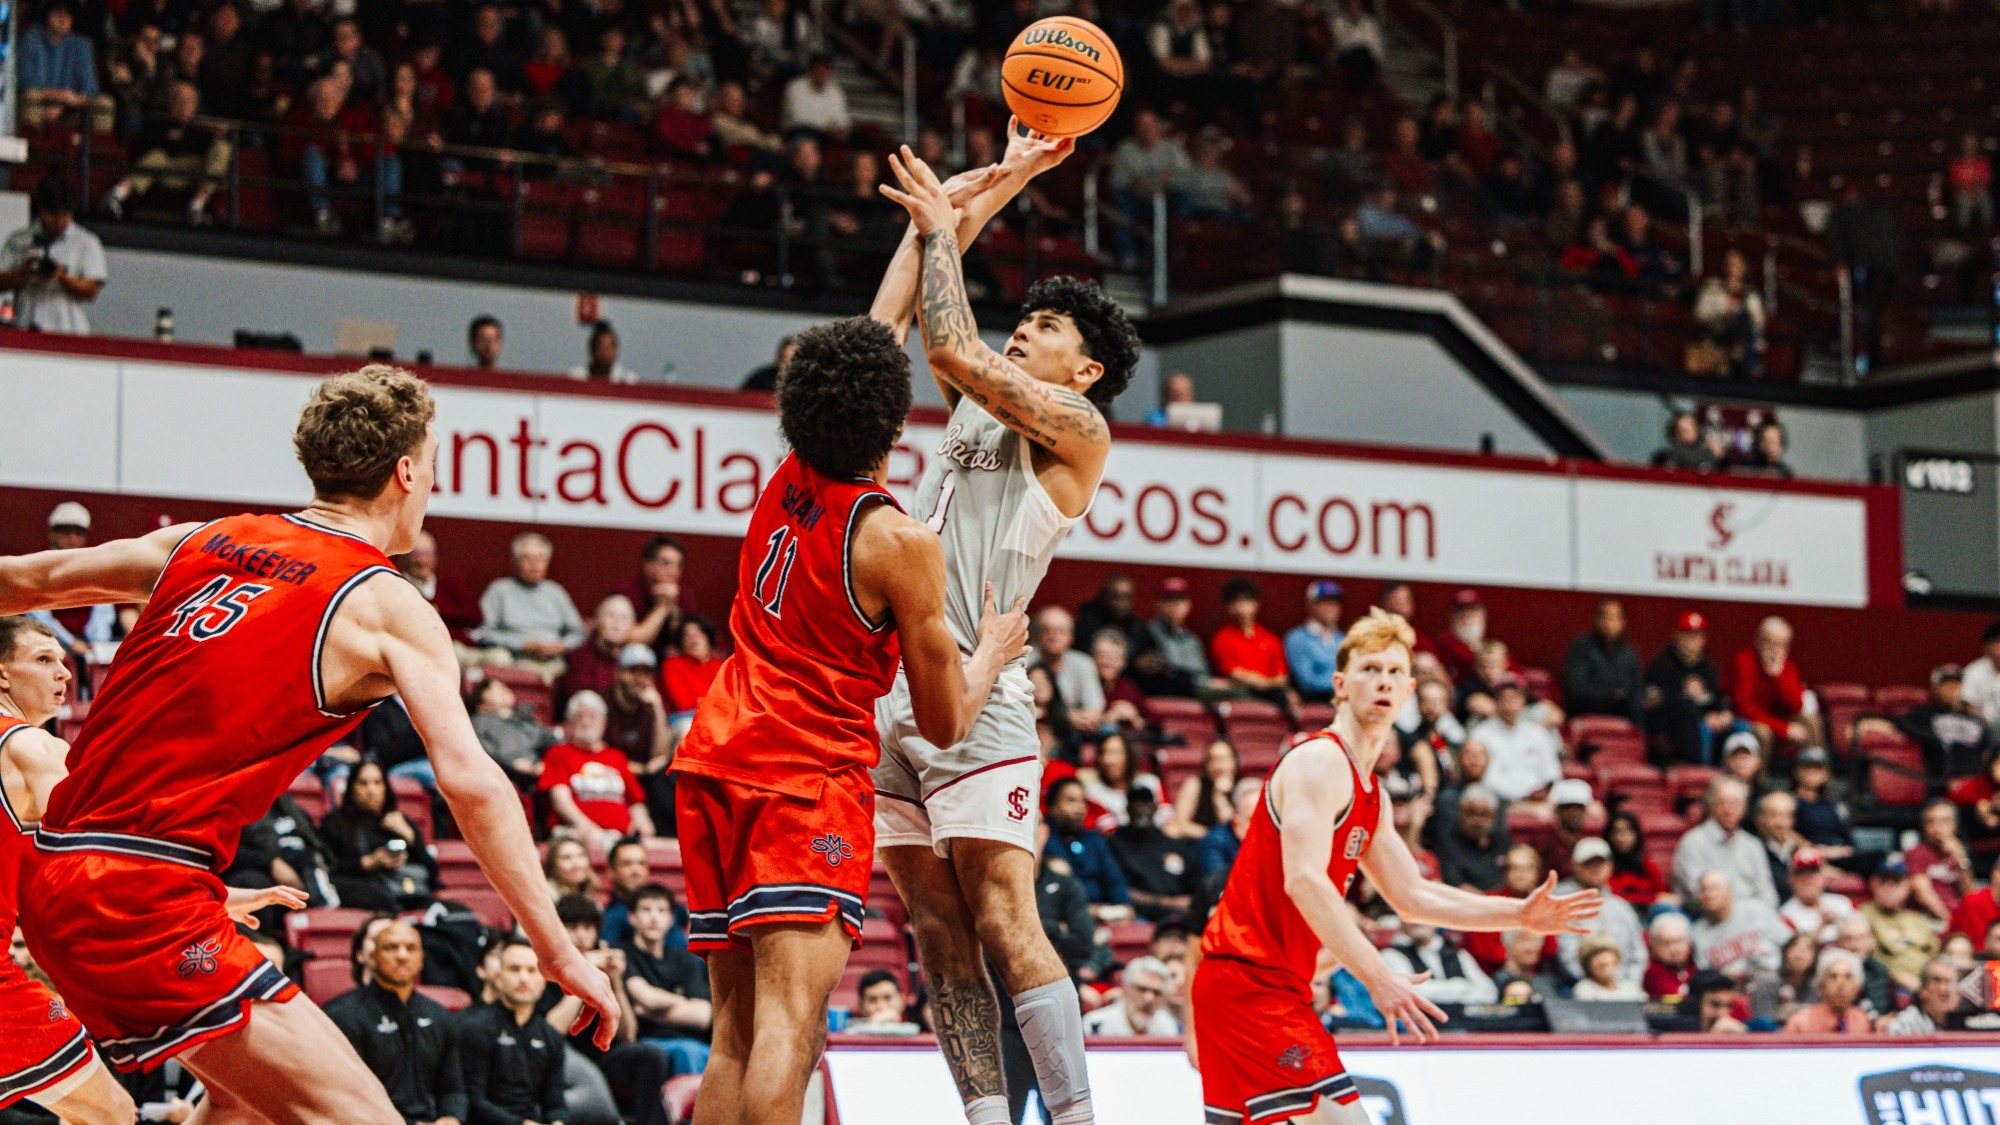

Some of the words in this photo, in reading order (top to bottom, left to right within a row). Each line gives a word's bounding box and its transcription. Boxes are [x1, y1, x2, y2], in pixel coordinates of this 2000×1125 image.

[1024, 28, 1101, 63] Wilson
[1026, 68, 1075, 91] EVO
[781, 482, 826, 532] SHAW
[925, 469, 956, 535] 1
[200, 533, 317, 586] McKEEVER
[752, 524, 798, 620] 11
[162, 573, 274, 642] 45
